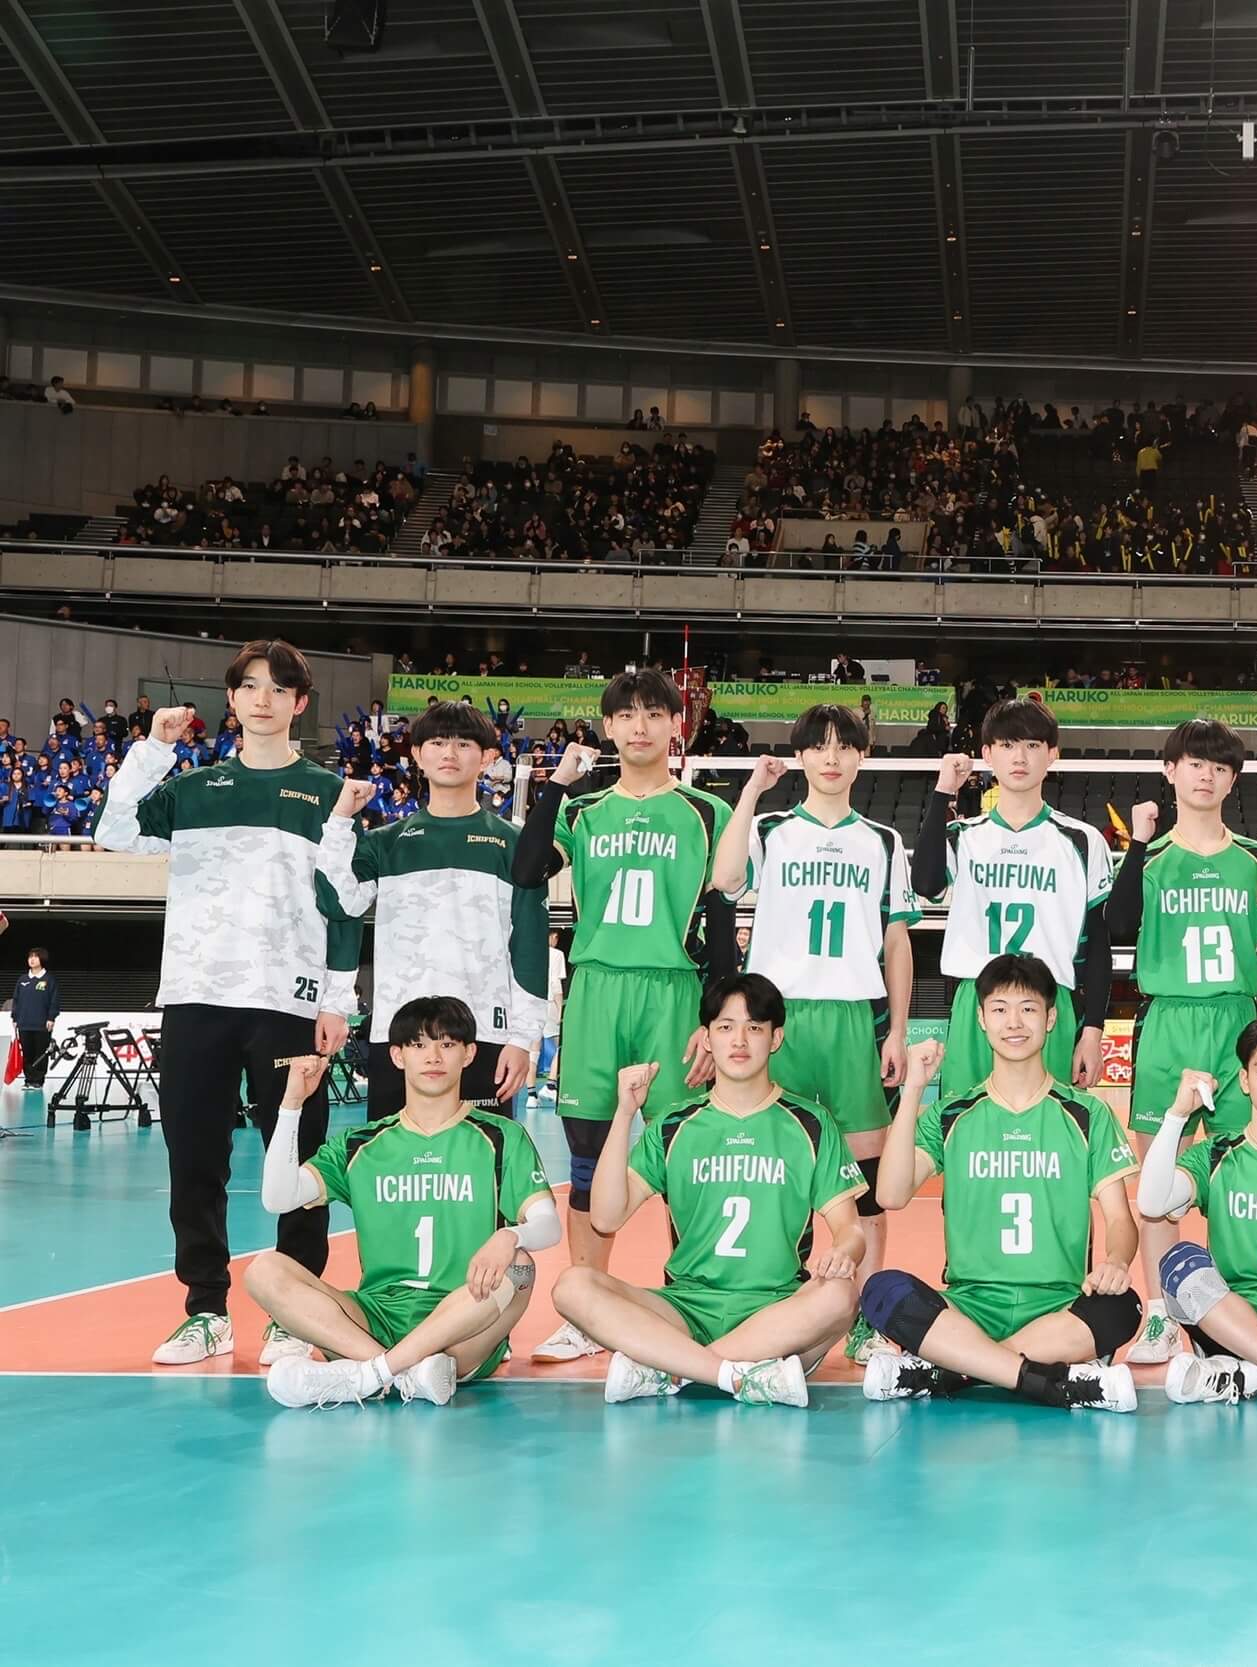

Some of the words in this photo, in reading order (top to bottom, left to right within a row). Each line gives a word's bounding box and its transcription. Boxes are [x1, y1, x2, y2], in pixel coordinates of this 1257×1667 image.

[392, 676, 460, 692] HARUKO
[713, 684, 778, 696] HARUKO
[1044, 690, 1109, 703] HARUKO
[563, 705, 603, 718] HARU
[879, 709, 930, 721] HARUK
[280, 788, 321, 805] ICHIFUNA
[466, 834, 507, 849] ICHIFUNA
[589, 830, 677, 860] ICHIFUNA
[781, 861, 871, 894] ICHIFUNA
[969, 859, 1056, 894] ICHIFUNA
[602, 867, 655, 927] 10
[1160, 887, 1249, 916] ICHIFUNA
[808, 899, 846, 958] 11
[985, 901, 1036, 955] 12
[1181, 925, 1236, 984] 13
[293, 976, 319, 1003] 25
[907, 1026, 944, 1037] SCHOOL
[691, 1154, 786, 1186] ICHIFUNA
[968, 1149, 1062, 1181] ICHIFUNA
[374, 1173, 474, 1203] ICHIFUNA
[714, 1195, 752, 1258] 2
[1000, 1192, 1034, 1255] 3
[414, 1215, 434, 1278] 1
